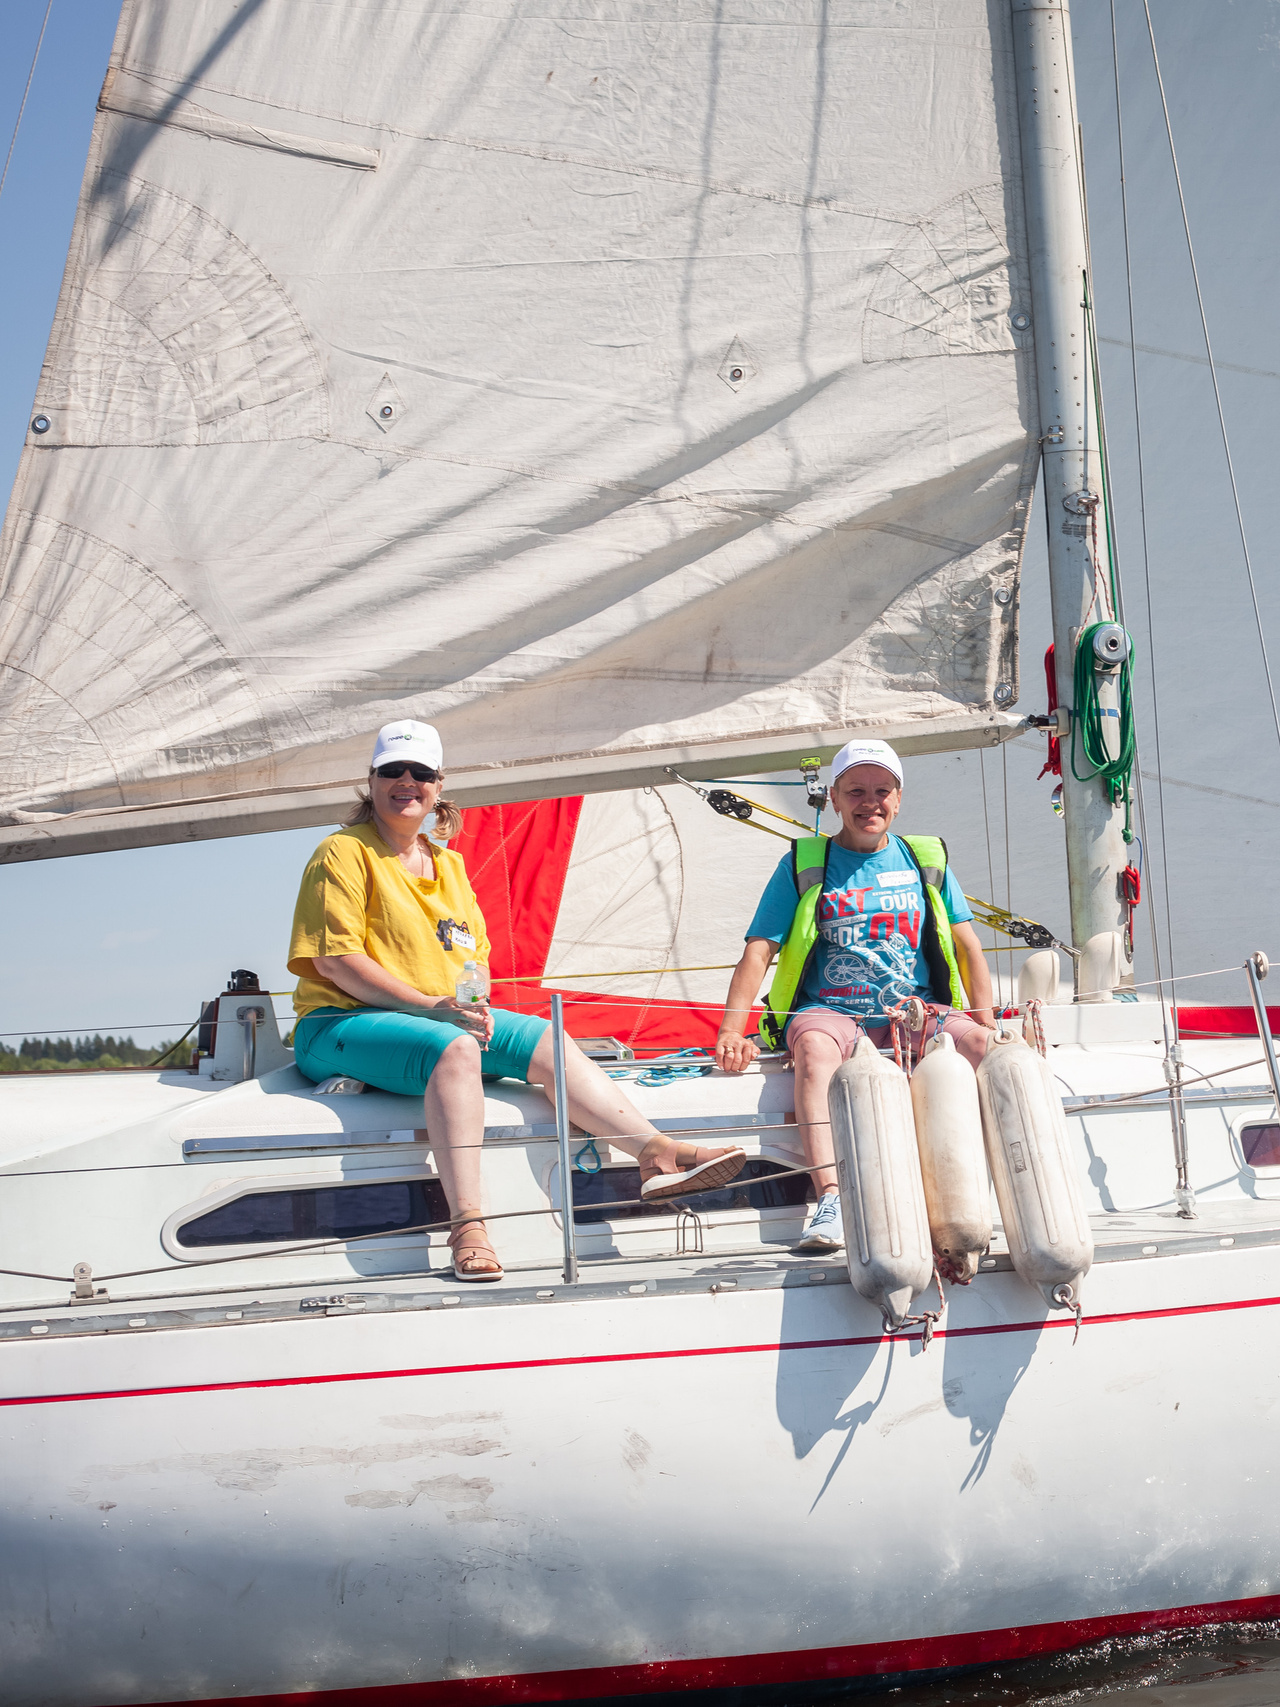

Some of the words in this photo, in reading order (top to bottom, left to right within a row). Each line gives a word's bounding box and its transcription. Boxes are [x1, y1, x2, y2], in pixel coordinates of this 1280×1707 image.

[820, 886, 874, 920] GET
[879, 891, 919, 912] OUR
[869, 910, 921, 949] ON
[819, 985, 872, 997] DOWNHILL
[844, 997, 875, 1005] SERIES
